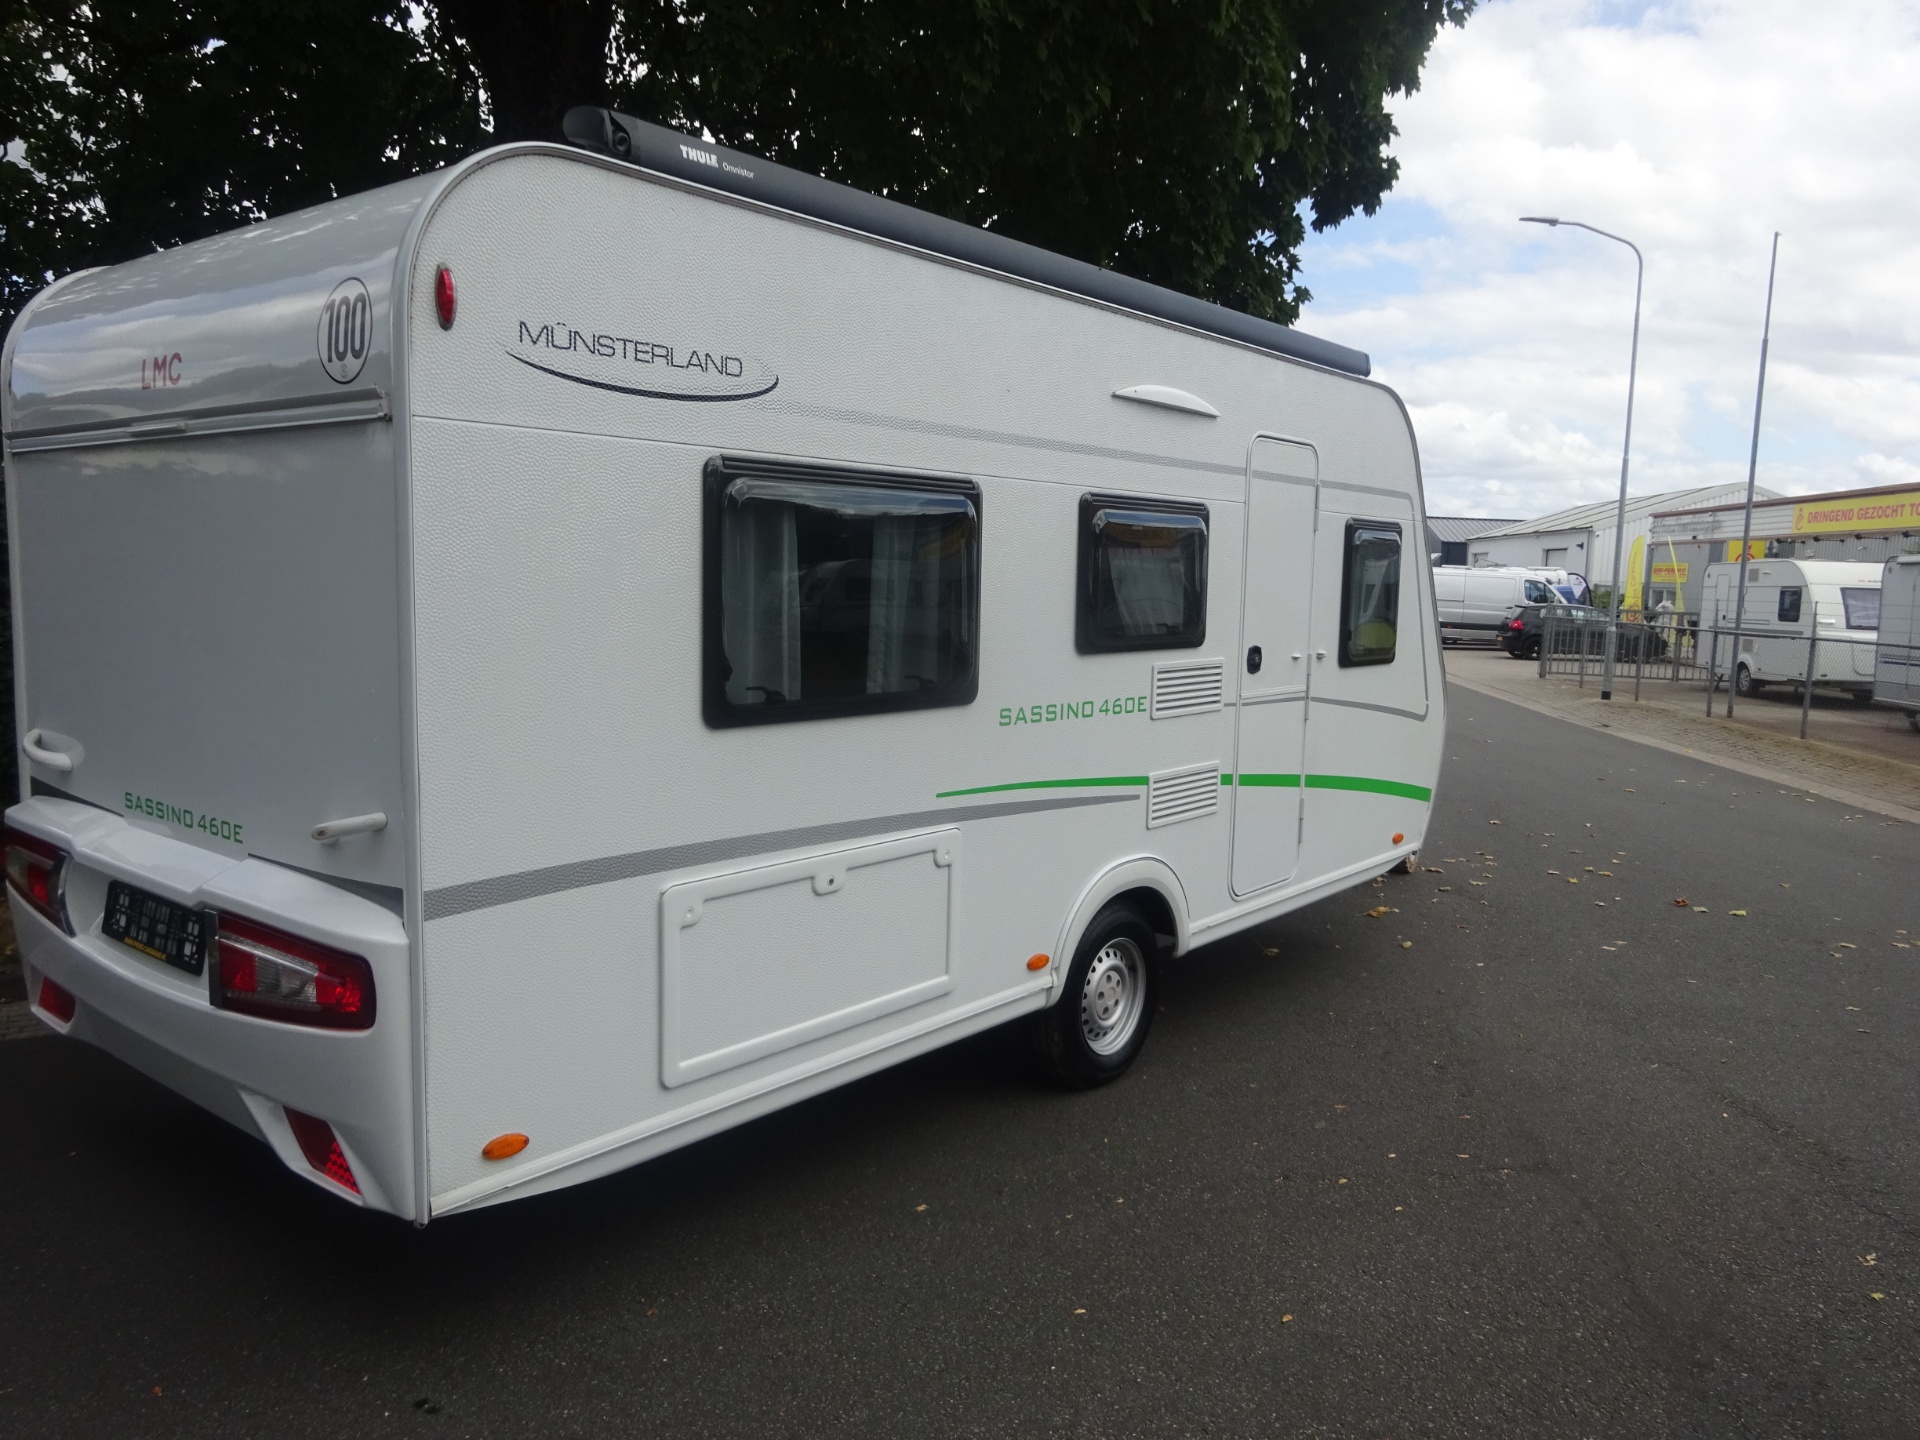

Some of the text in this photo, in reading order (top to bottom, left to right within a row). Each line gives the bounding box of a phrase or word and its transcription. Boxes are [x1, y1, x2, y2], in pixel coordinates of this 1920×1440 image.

[680, 144, 754, 179] THULE Omnistor
[325, 292, 367, 363] 100
[519, 321, 743, 377] MÜNSTERLAND
[142, 352, 182, 390] LMC
[1807, 508, 1854, 523] DRINGEND
[1857, 504, 1906, 520] GEZOCHT
[999, 696, 1148, 727] SASSINO 460E
[124, 791, 243, 844] SASSINO 460E
